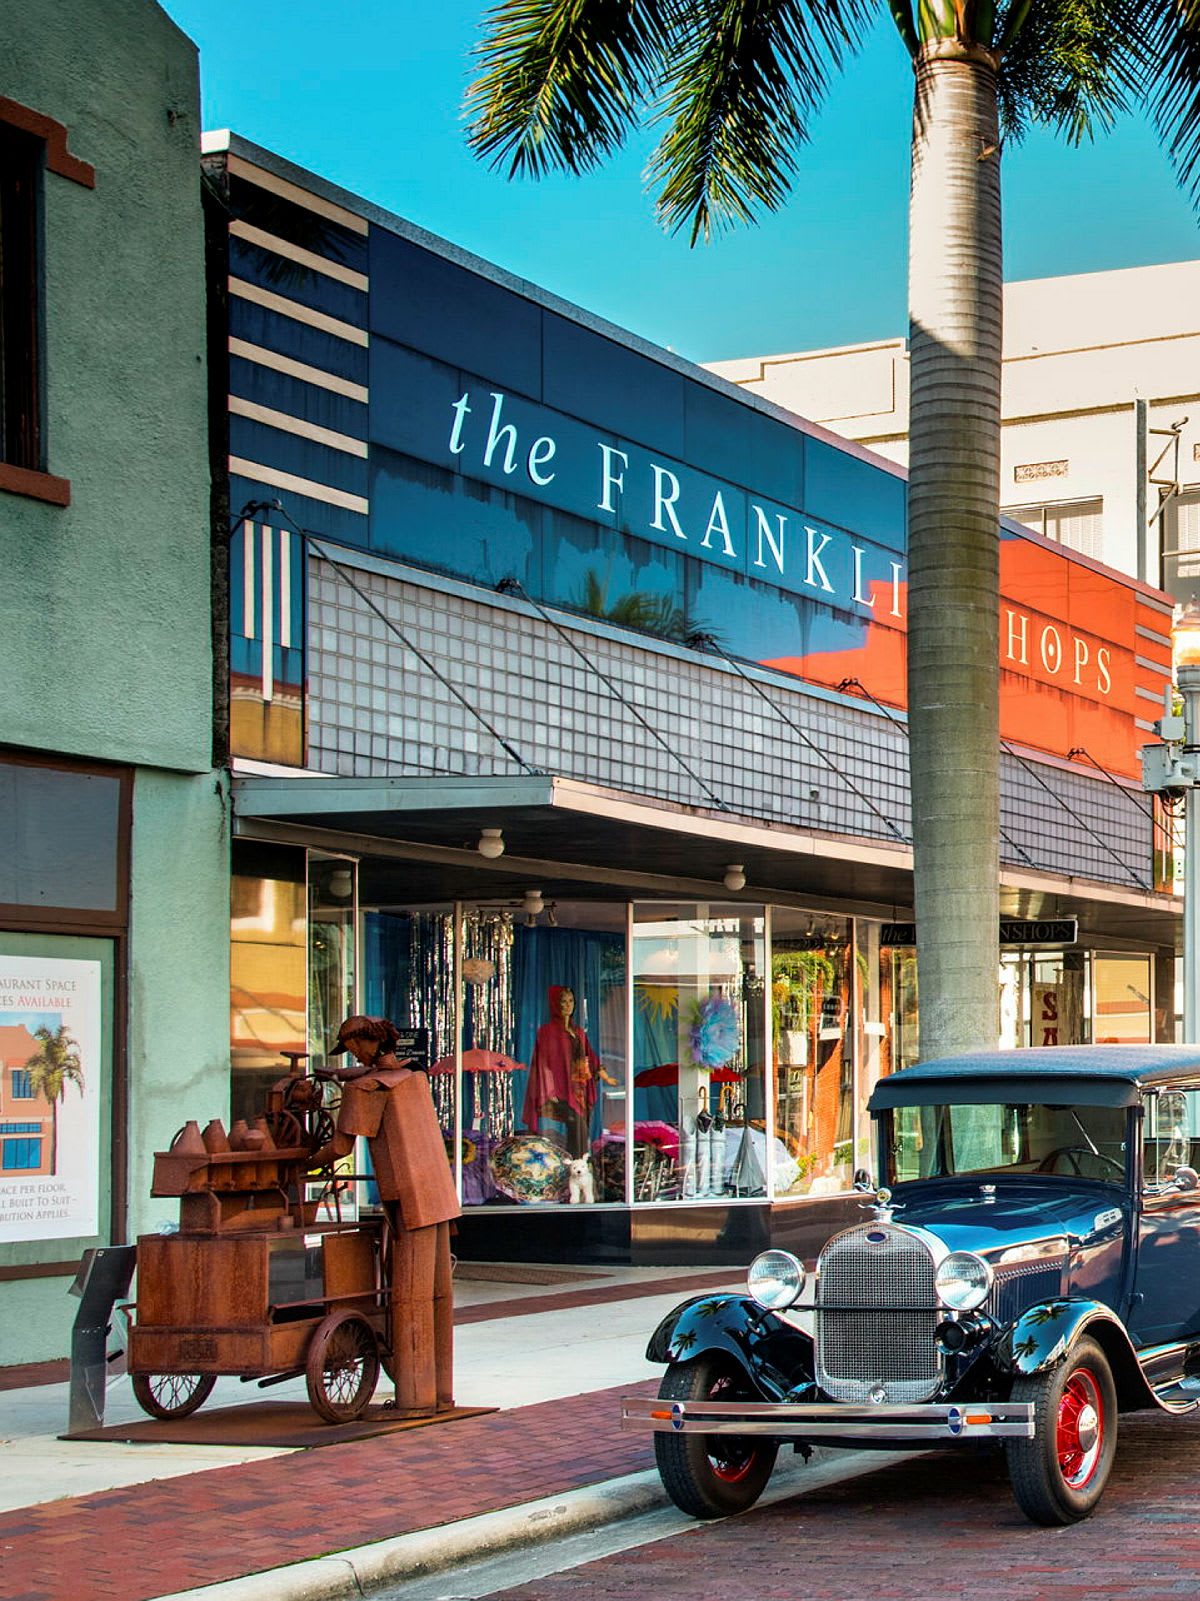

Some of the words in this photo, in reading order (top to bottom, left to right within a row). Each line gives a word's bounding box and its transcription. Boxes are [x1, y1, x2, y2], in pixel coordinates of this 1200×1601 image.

[450, 392, 556, 486] the
[597, 442, 903, 618] FRANKLI
[1004, 609, 1112, 694] HOPS
[882, 925, 908, 942] the
